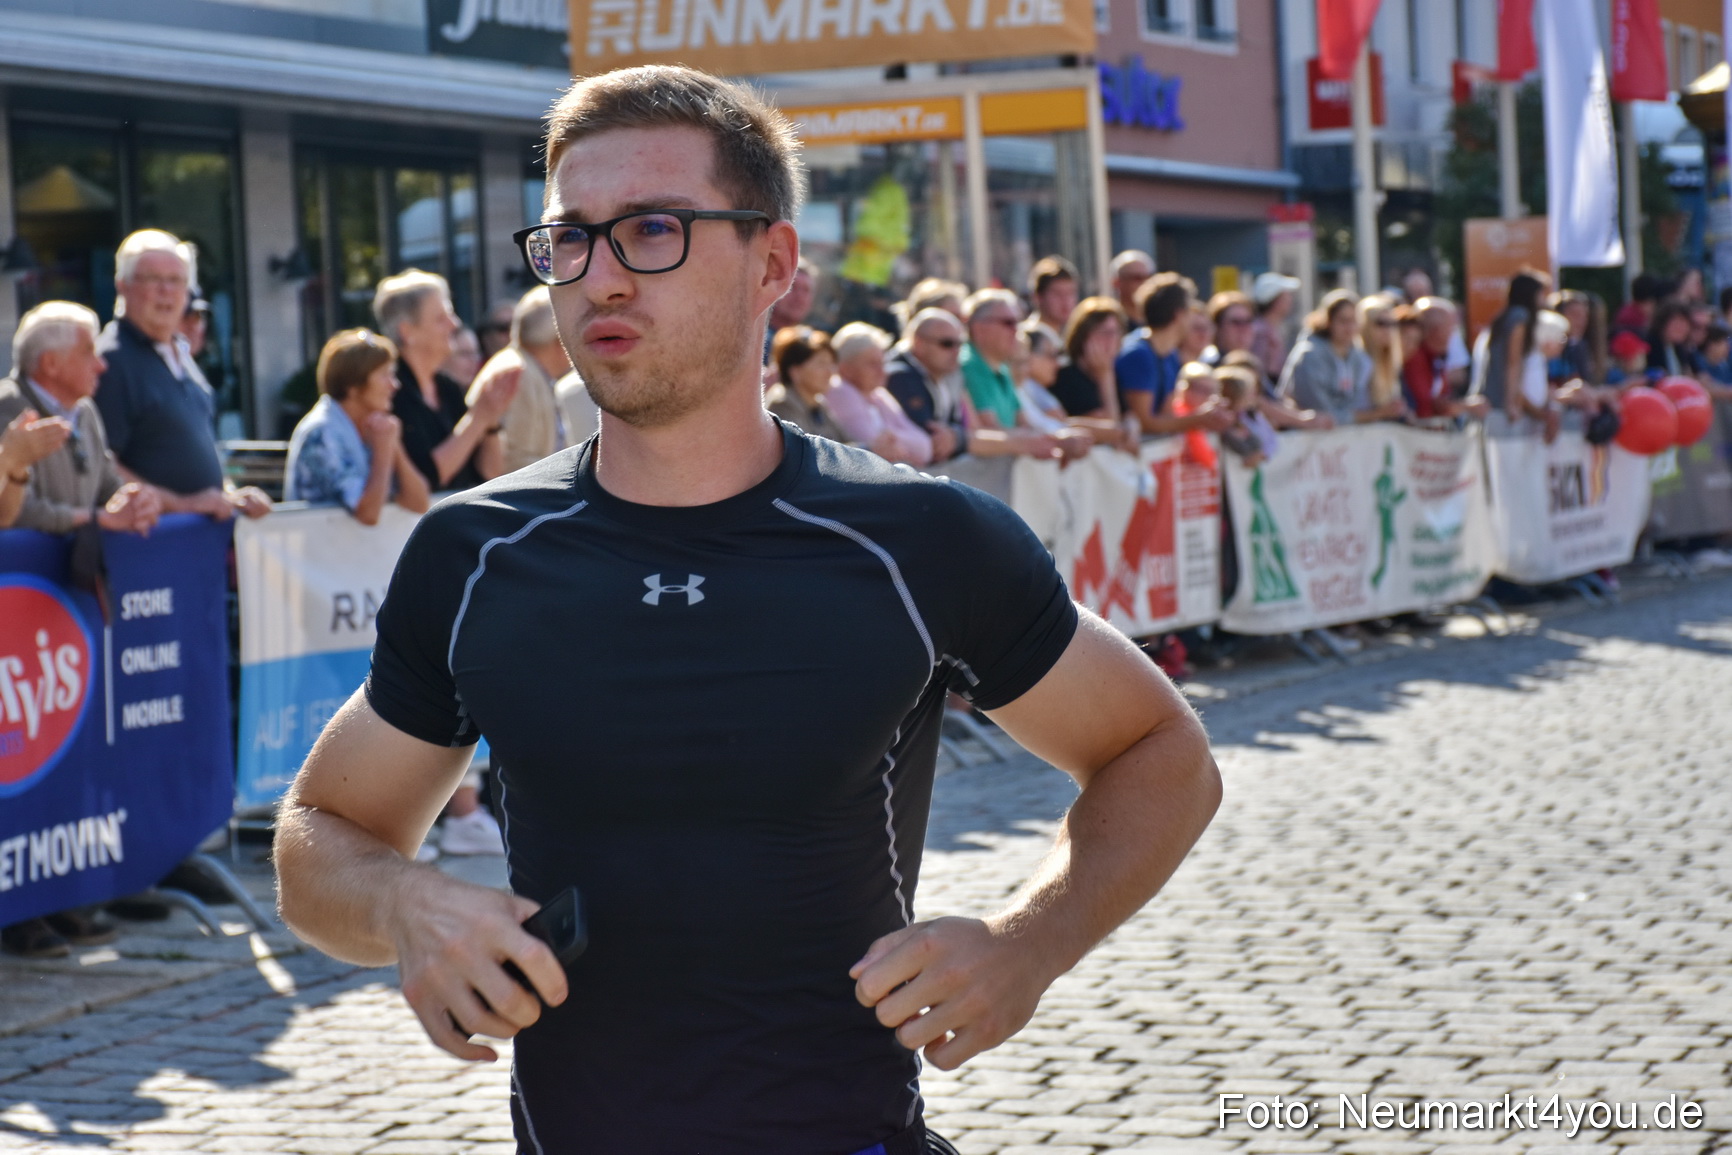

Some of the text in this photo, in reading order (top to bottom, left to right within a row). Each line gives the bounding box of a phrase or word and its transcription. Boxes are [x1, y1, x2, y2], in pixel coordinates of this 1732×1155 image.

[121, 586, 174, 621] STORE
[331, 587, 387, 633] RA
[121, 640, 181, 676] ONLINE
[122, 694, 185, 731] MOBILE
